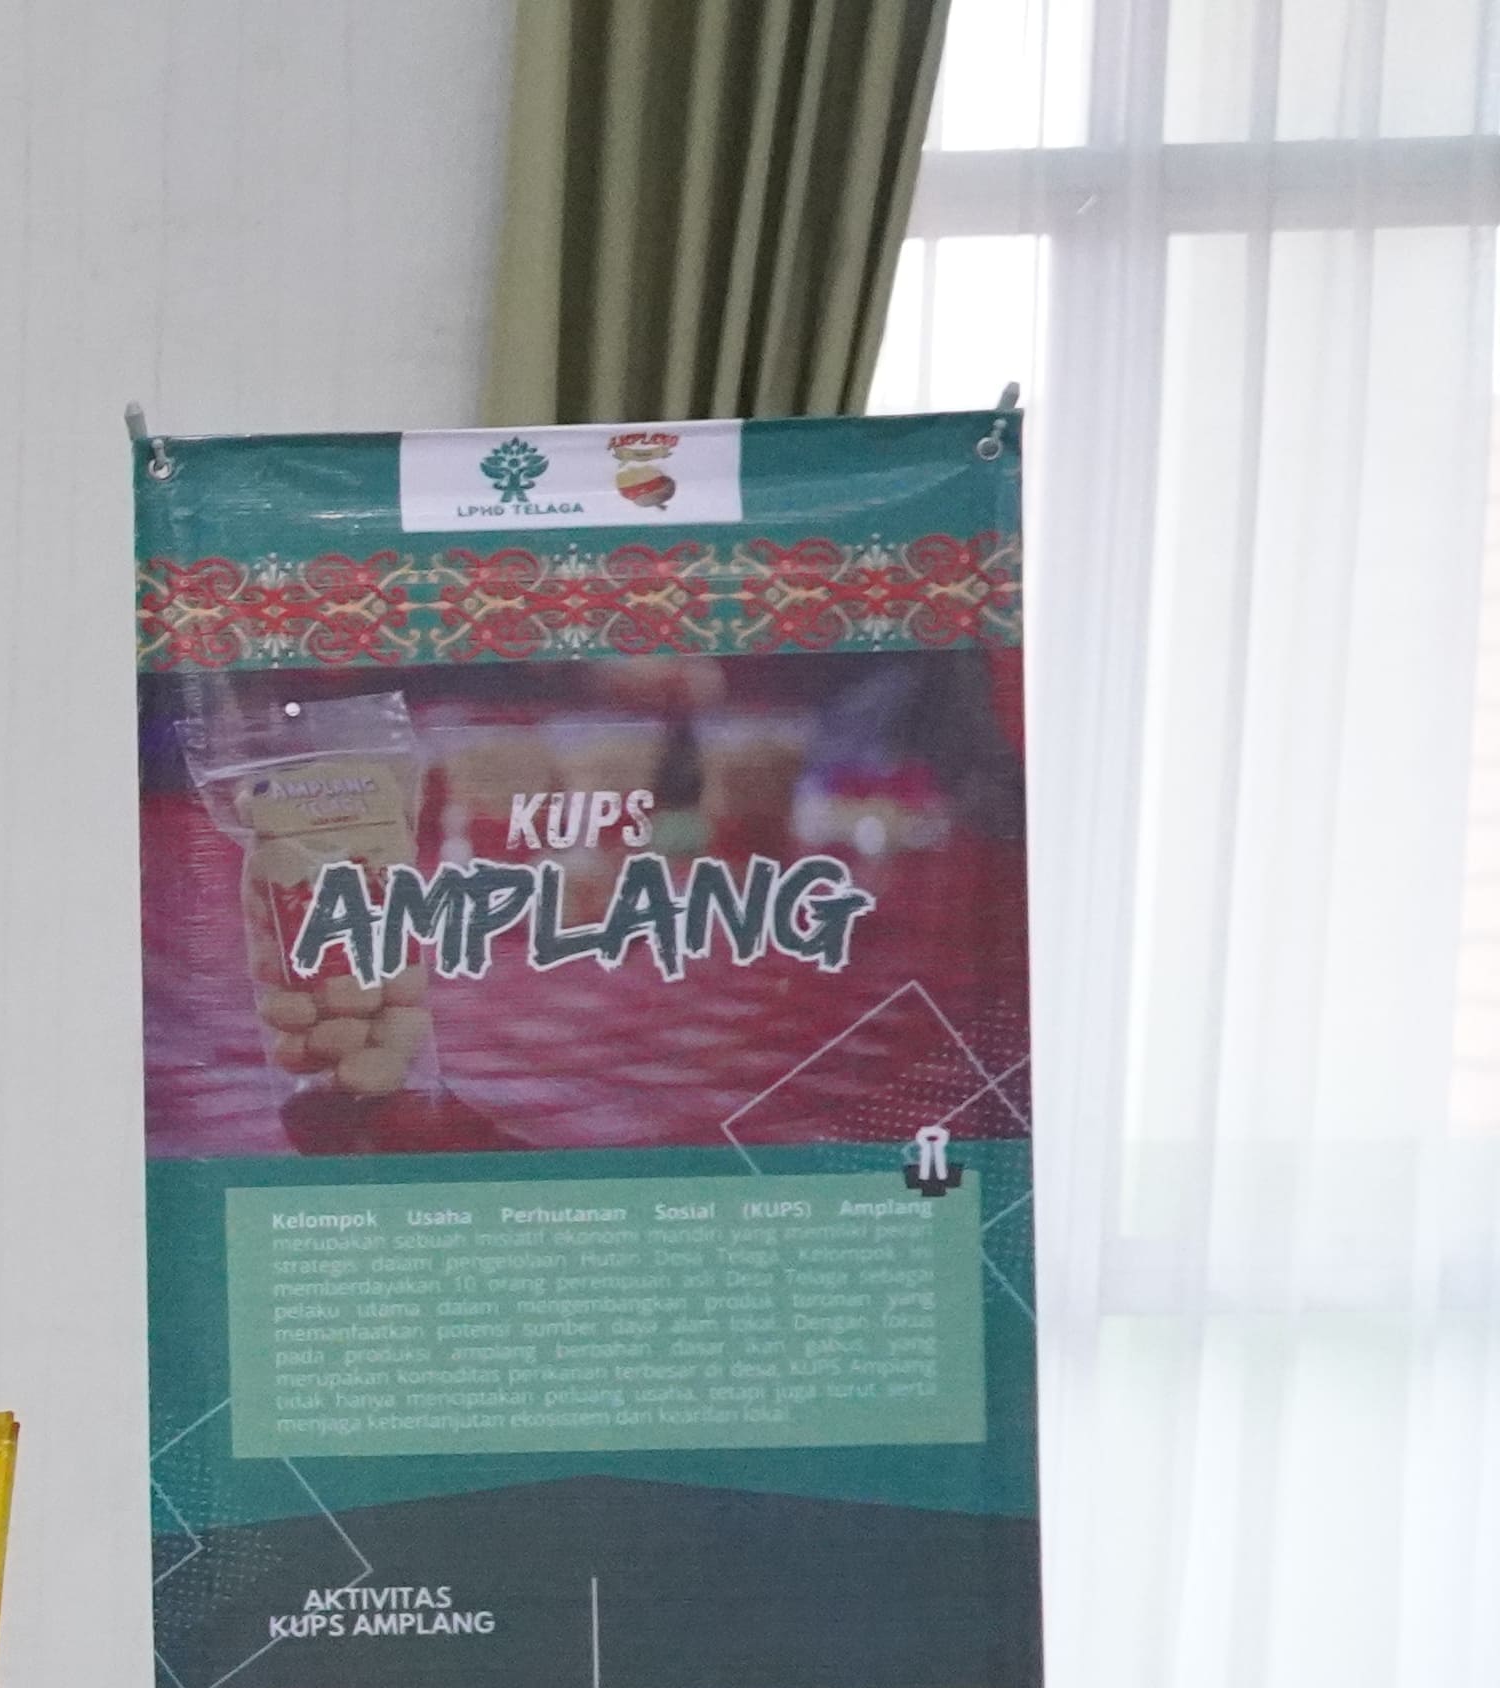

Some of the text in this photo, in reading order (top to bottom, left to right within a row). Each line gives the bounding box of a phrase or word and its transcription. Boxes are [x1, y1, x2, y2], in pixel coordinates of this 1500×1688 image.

[458, 502, 584, 517] LPHD TELAGA
[505, 790, 655, 851] KUPS
[292, 854, 876, 989] AMPLANG
[272, 1198, 933, 1232] Kelompok Usaha Perhutanan Sosial (KUPS) Amplang
[303, 1586, 452, 1611] AKTIVITAS
[269, 1612, 495, 1637] KUPS AMPLANG
